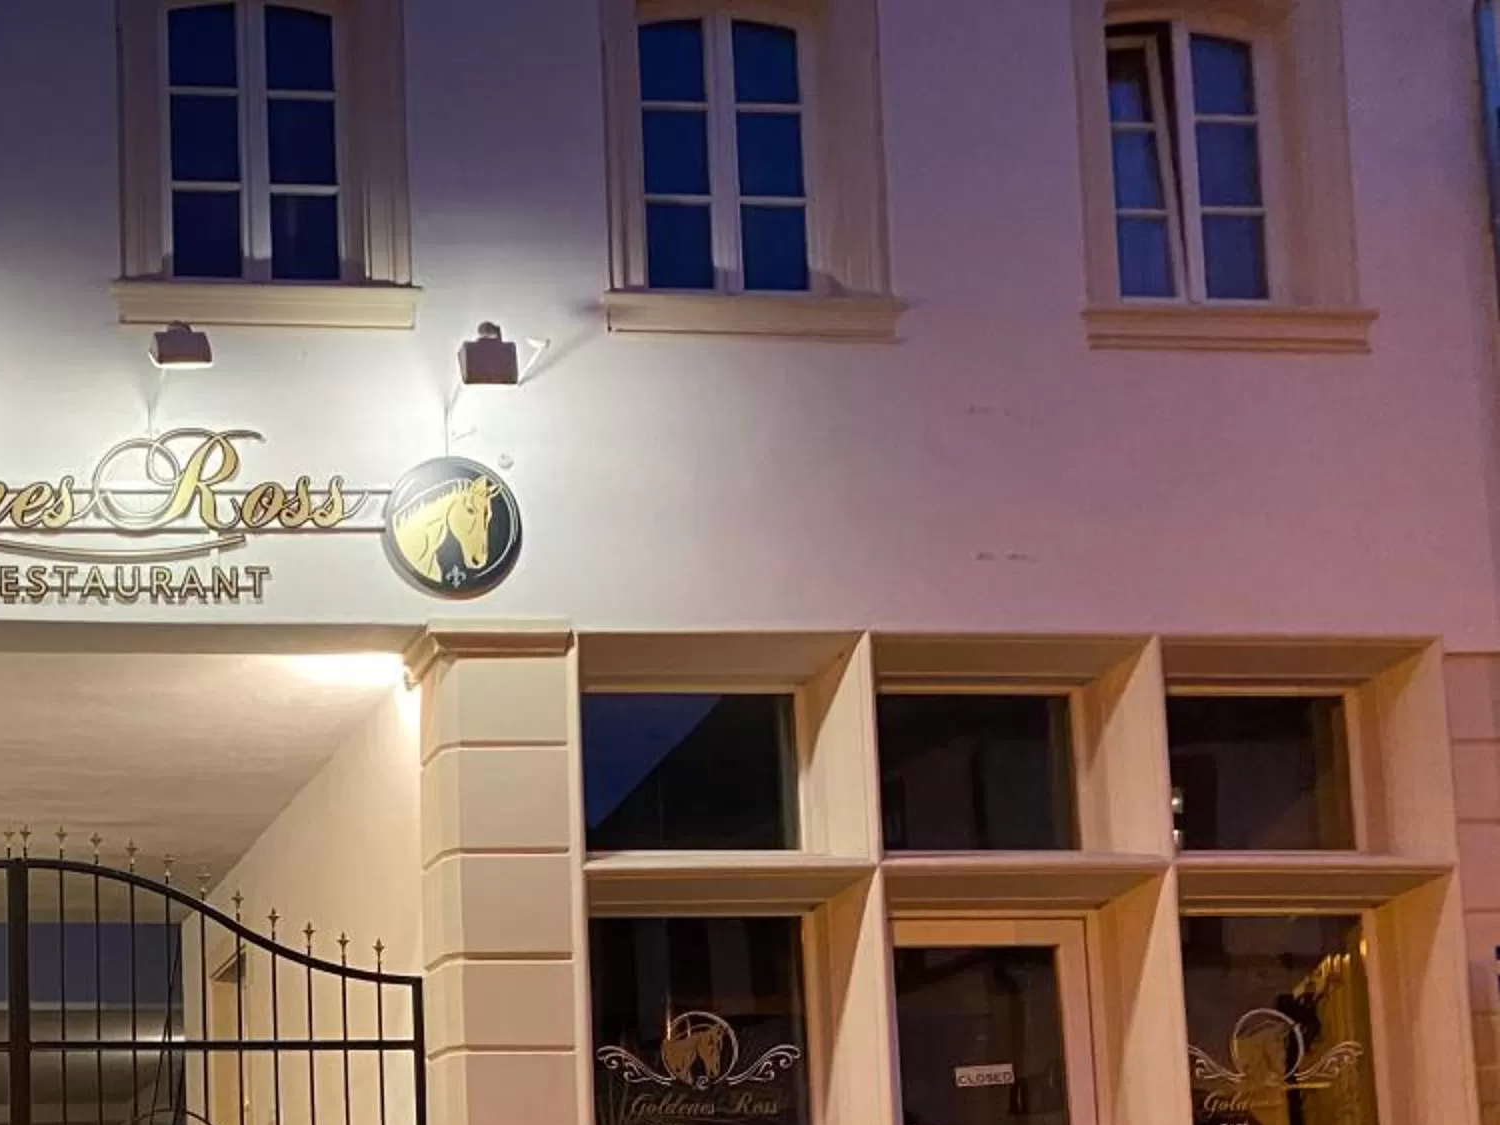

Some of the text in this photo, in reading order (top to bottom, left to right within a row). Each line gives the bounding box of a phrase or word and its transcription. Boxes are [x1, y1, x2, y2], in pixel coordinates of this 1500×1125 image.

[92, 427, 369, 531] Ross
[957, 1071, 1014, 1085] CLOSED
[627, 1091, 779, 1120] Goldenes Ross
